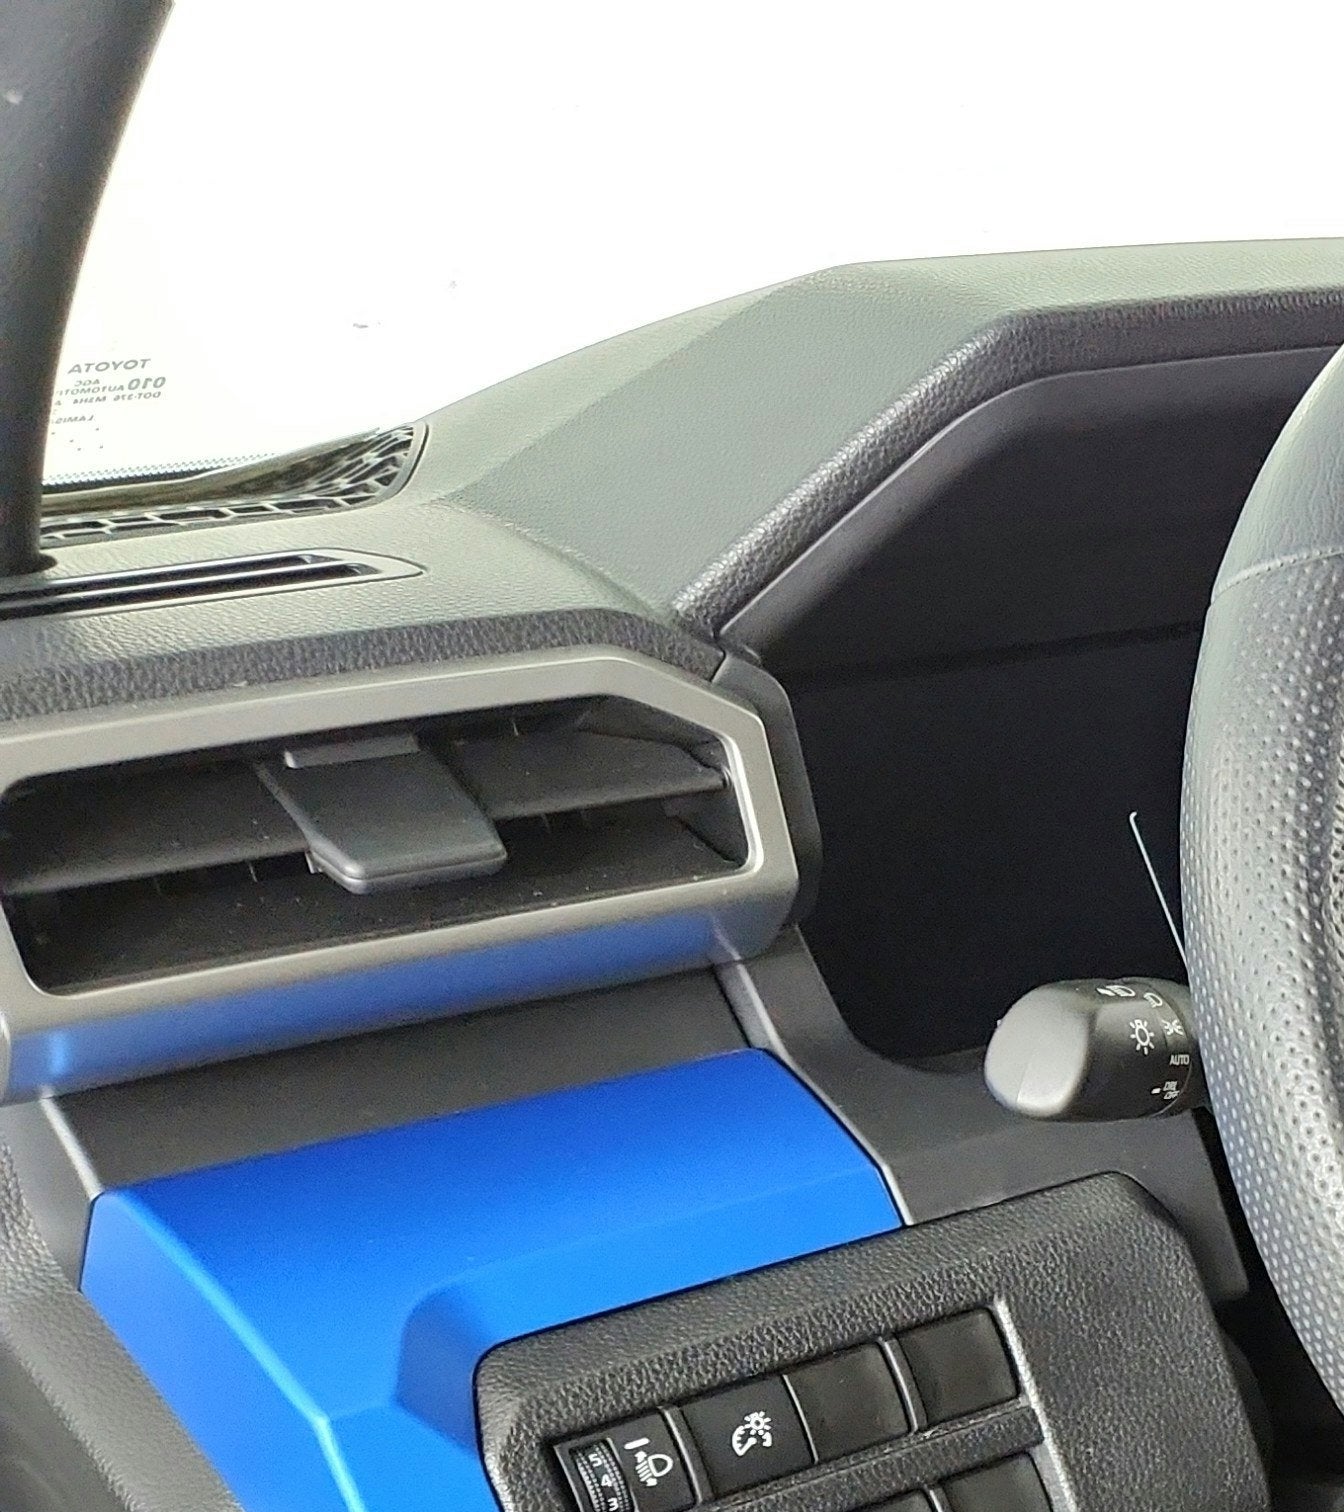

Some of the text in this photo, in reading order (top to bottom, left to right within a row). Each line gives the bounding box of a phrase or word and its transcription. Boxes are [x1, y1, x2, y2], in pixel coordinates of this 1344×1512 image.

[1169, 1054, 1190, 1066] AUTO
[588, 1453, 603, 1468] 5
[601, 1473, 612, 1487] 4
[607, 1497, 619, 1512] 3
